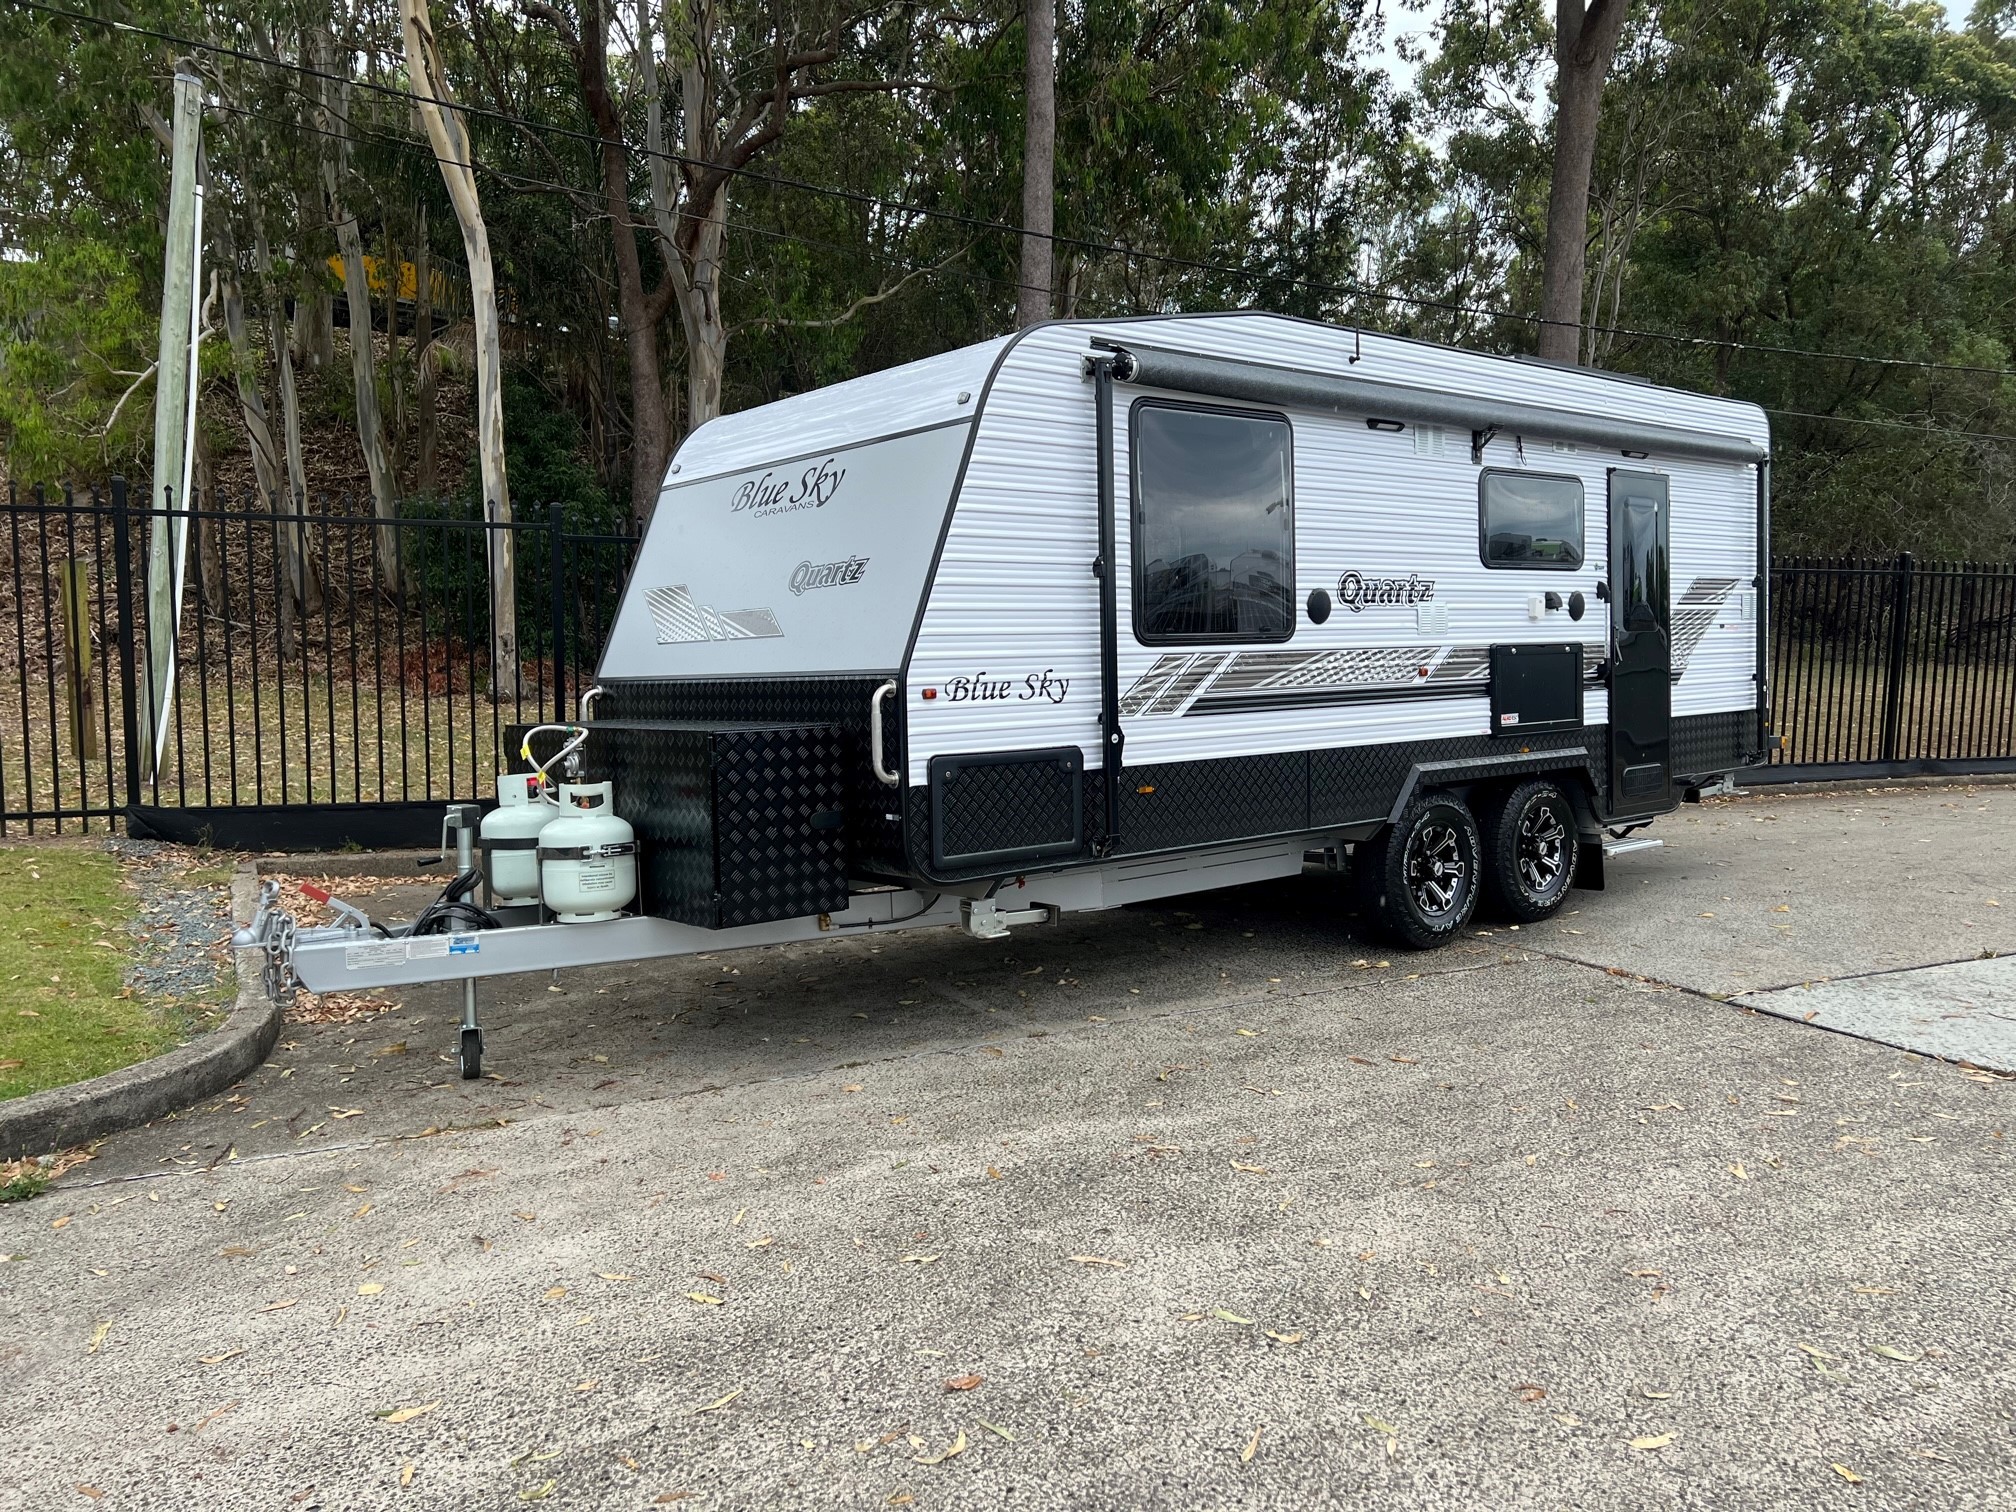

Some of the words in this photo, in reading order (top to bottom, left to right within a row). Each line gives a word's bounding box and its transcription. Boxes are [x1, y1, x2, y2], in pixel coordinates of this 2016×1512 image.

[731, 472, 789, 513] Blue
[789, 458, 846, 508] Sky
[753, 500, 815, 518] CARAVANS
[788, 555, 870, 597] Quartz
[1337, 569, 1435, 613] Quartz
[944, 671, 1012, 702] Blue
[1018, 668, 1070, 704] Sky
[1455, 825, 1479, 924] ADVENTURE
